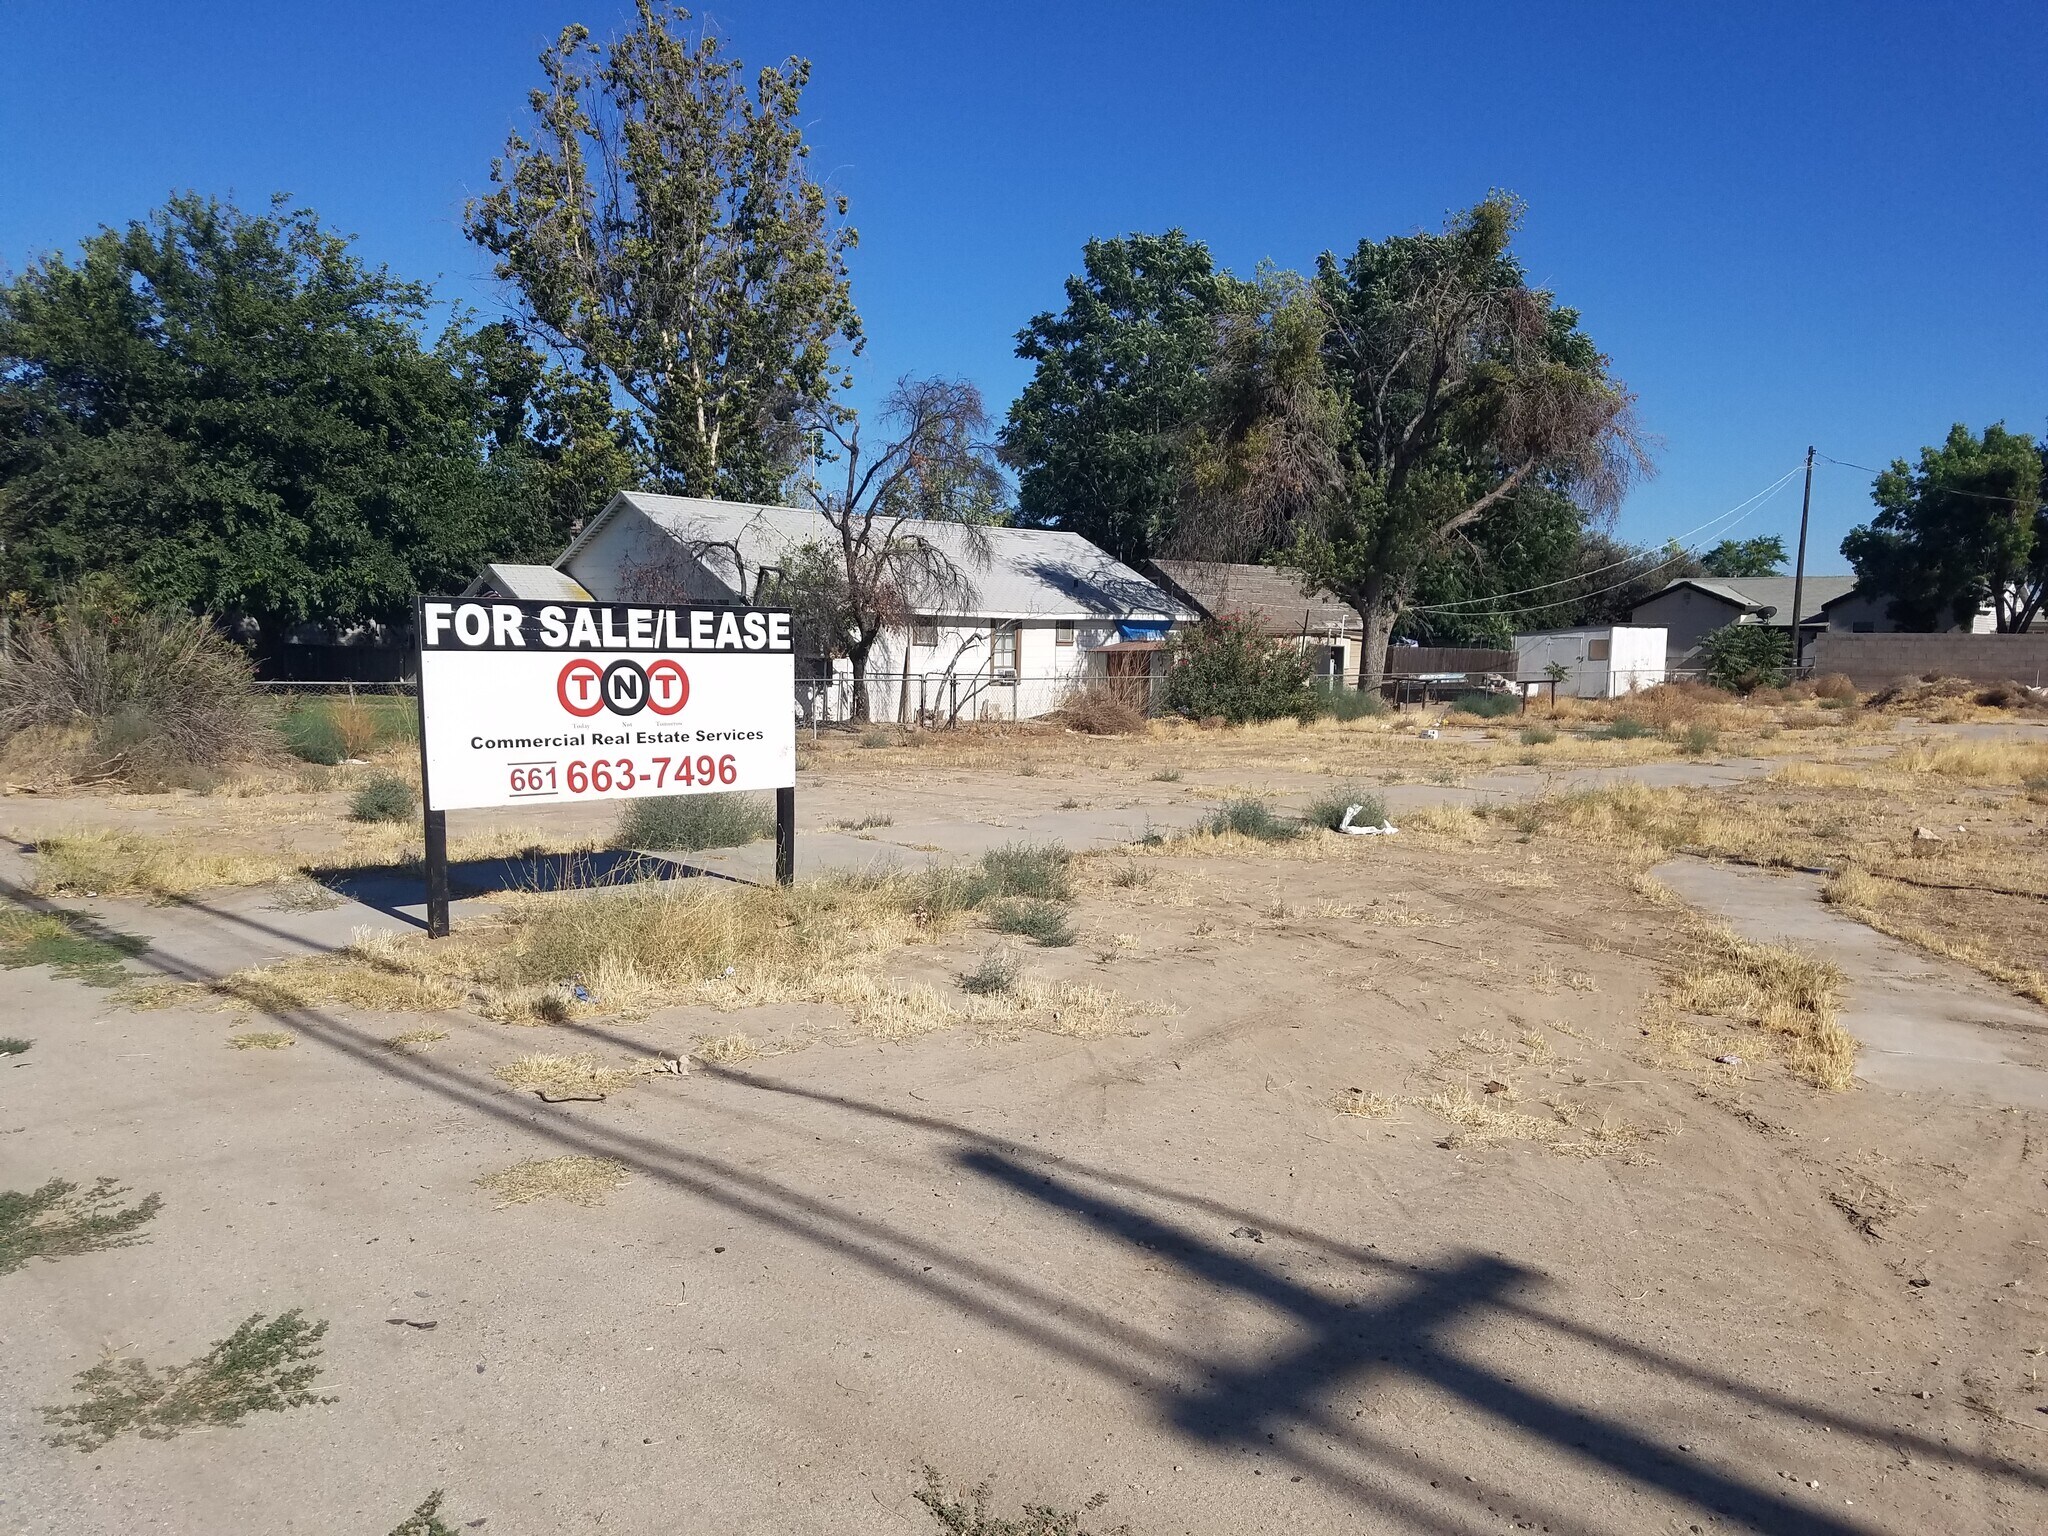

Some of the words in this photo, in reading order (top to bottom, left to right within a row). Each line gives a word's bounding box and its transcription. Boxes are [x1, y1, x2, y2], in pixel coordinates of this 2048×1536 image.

[425, 602, 526, 647] FOR
[539, 605, 792, 650] SALE/LEASE
[470, 733, 585, 750] Commercial
[592, 732, 630, 746] Real
[636, 731, 691, 744] Estate
[696, 729, 764, 742] Services
[509, 766, 558, 791] 661
[566, 754, 738, 794] 663-7496
